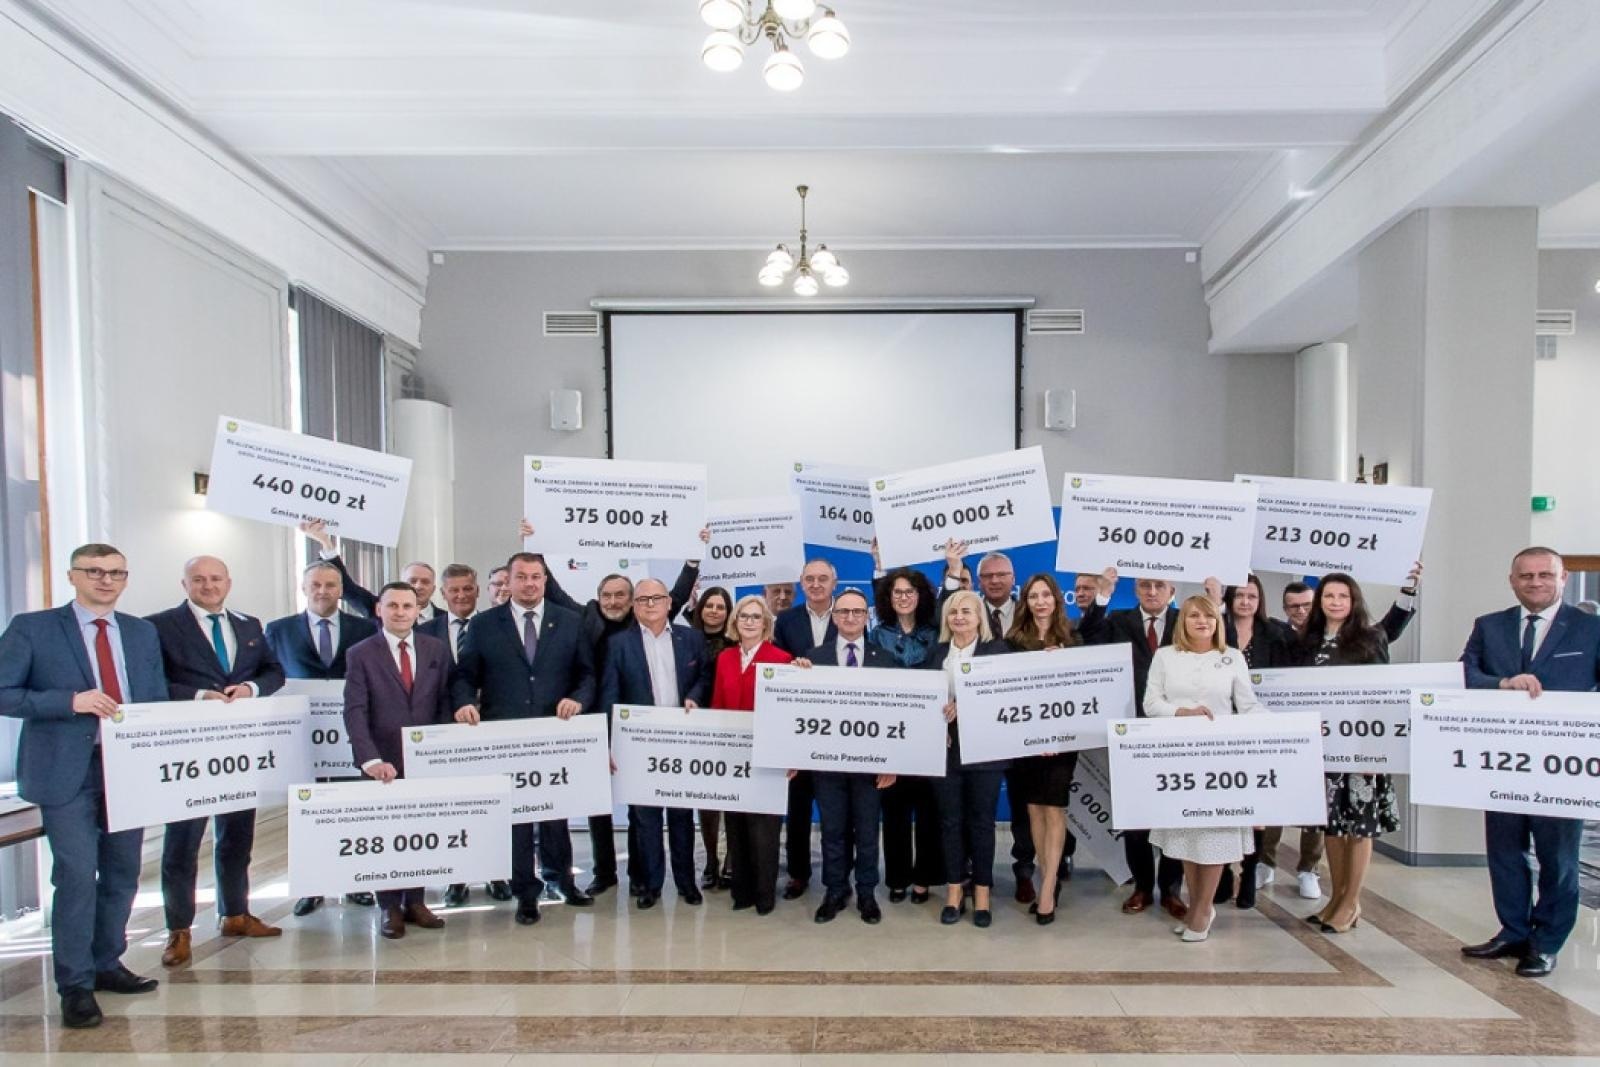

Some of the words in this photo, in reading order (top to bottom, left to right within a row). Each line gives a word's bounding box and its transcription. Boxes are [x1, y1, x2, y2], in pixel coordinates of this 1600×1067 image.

[253, 474, 294, 494] 440
[301, 484, 340, 504] 000
[346, 494, 366, 510] zł
[565, 507, 599, 523] 375
[606, 509, 643, 526] 000
[650, 510, 668, 527] zł
[820, 505, 847, 521] 164
[853, 509, 873, 525] 00
[911, 513, 947, 532] 400
[953, 505, 990, 525] 000
[996, 499, 1014, 517] zł
[1098, 526, 1137, 544] 360
[1144, 529, 1184, 547] 000
[1190, 532, 1210, 550] zł
[1266, 525, 1301, 543] 213
[1310, 529, 1350, 548] 000
[1357, 534, 1377, 550] zł
[711, 544, 744, 560] 000
[750, 541, 766, 557] zł
[997, 705, 1032, 724] 425
[1040, 700, 1075, 720] 200
[1082, 697, 1099, 715] zł
[312, 729, 339, 745] 00
[795, 718, 831, 735] 392
[839, 720, 879, 738] 000
[886, 721, 906, 739] zł
[1339, 720, 1385, 737] 000
[160, 760, 200, 783] 176
[208, 754, 250, 776] 000
[257, 750, 275, 770] zł
[647, 757, 683, 774] 368
[689, 759, 727, 777] 000
[733, 761, 751, 778] zł
[1453, 749, 1466, 768] 1
[1480, 751, 1531, 773] 122
[1543, 754, 1600, 777] 000
[511, 771, 542, 789] 50
[550, 767, 568, 785] zł
[1156, 773, 1196, 791] 335
[1205, 771, 1248, 790] 200
[1257, 769, 1277, 788] zł
[512, 802, 554, 814] aciborski
[1081, 794, 1109, 823] 000
[339, 836, 384, 857] 288
[393, 833, 439, 852] 000
[447, 829, 468, 849] zł
[390, 867, 453, 879] Ornontowice
